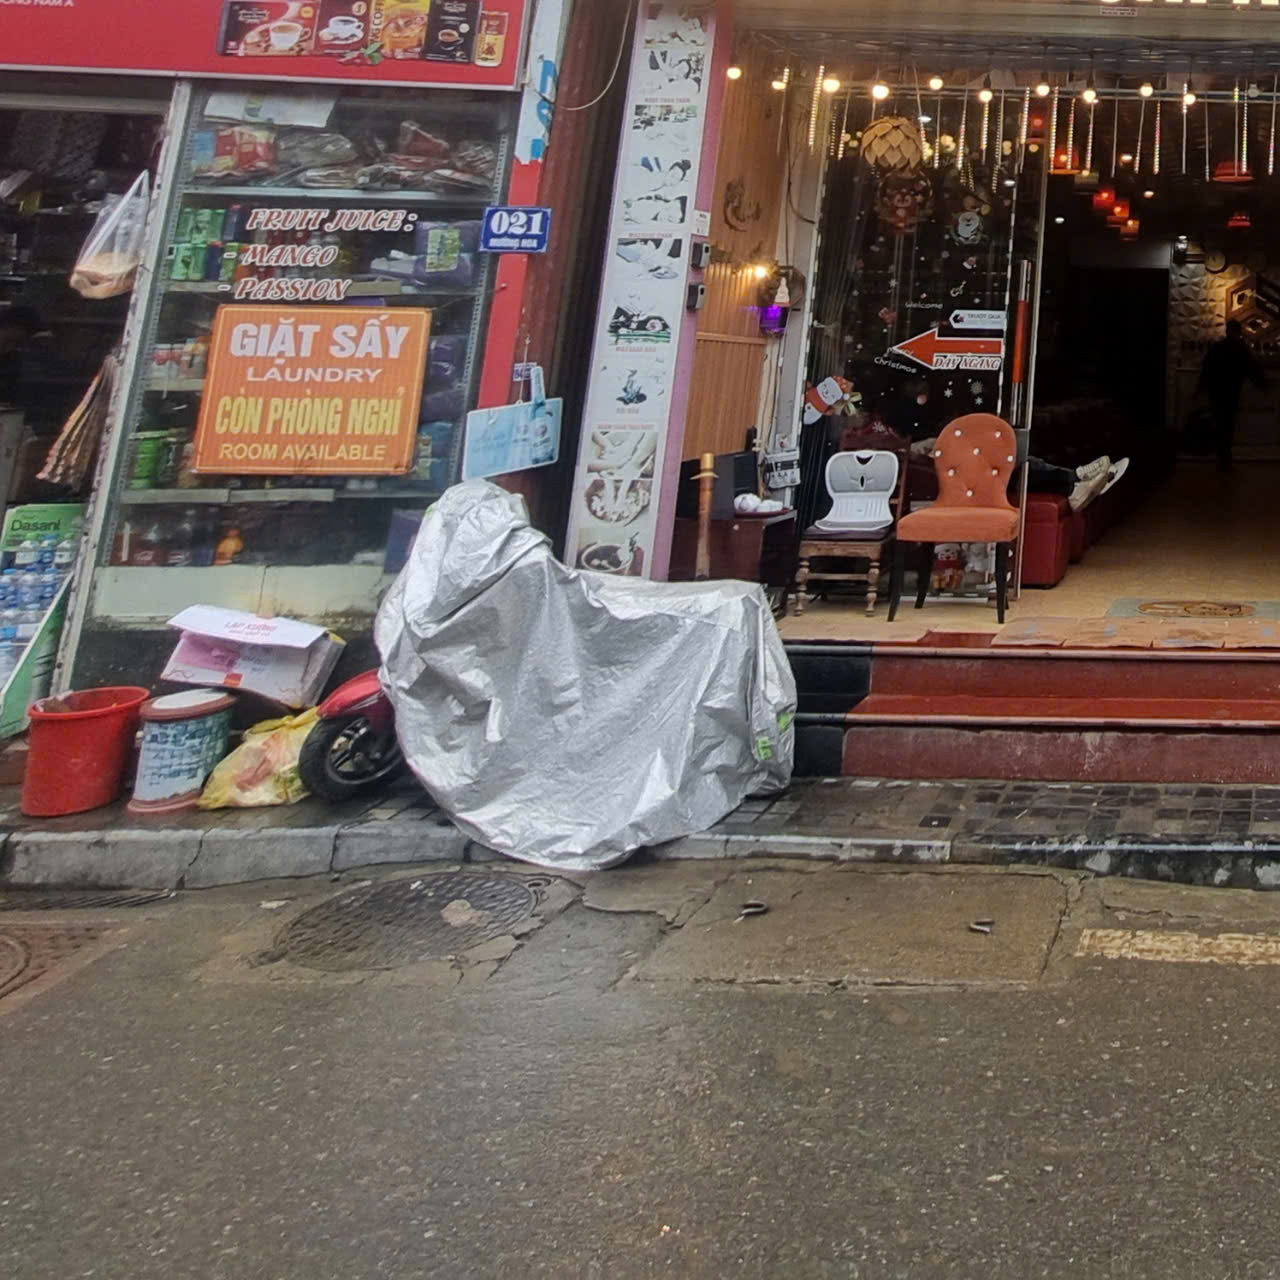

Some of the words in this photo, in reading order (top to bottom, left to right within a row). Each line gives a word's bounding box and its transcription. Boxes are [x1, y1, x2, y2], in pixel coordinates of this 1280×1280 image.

[246, 208, 328, 231] FRUIT
[490, 210, 544, 235] 021
[242, 243, 339, 267] MANGO
[234, 277, 352, 301] PASSION
[230, 316, 320, 365] GIẶT
[329, 313, 410, 359] SẤY
[247, 367, 383, 383] LAUNDRY
[219, 443, 278, 461] ROOM
[281, 443, 387, 461] AVAILABLE
